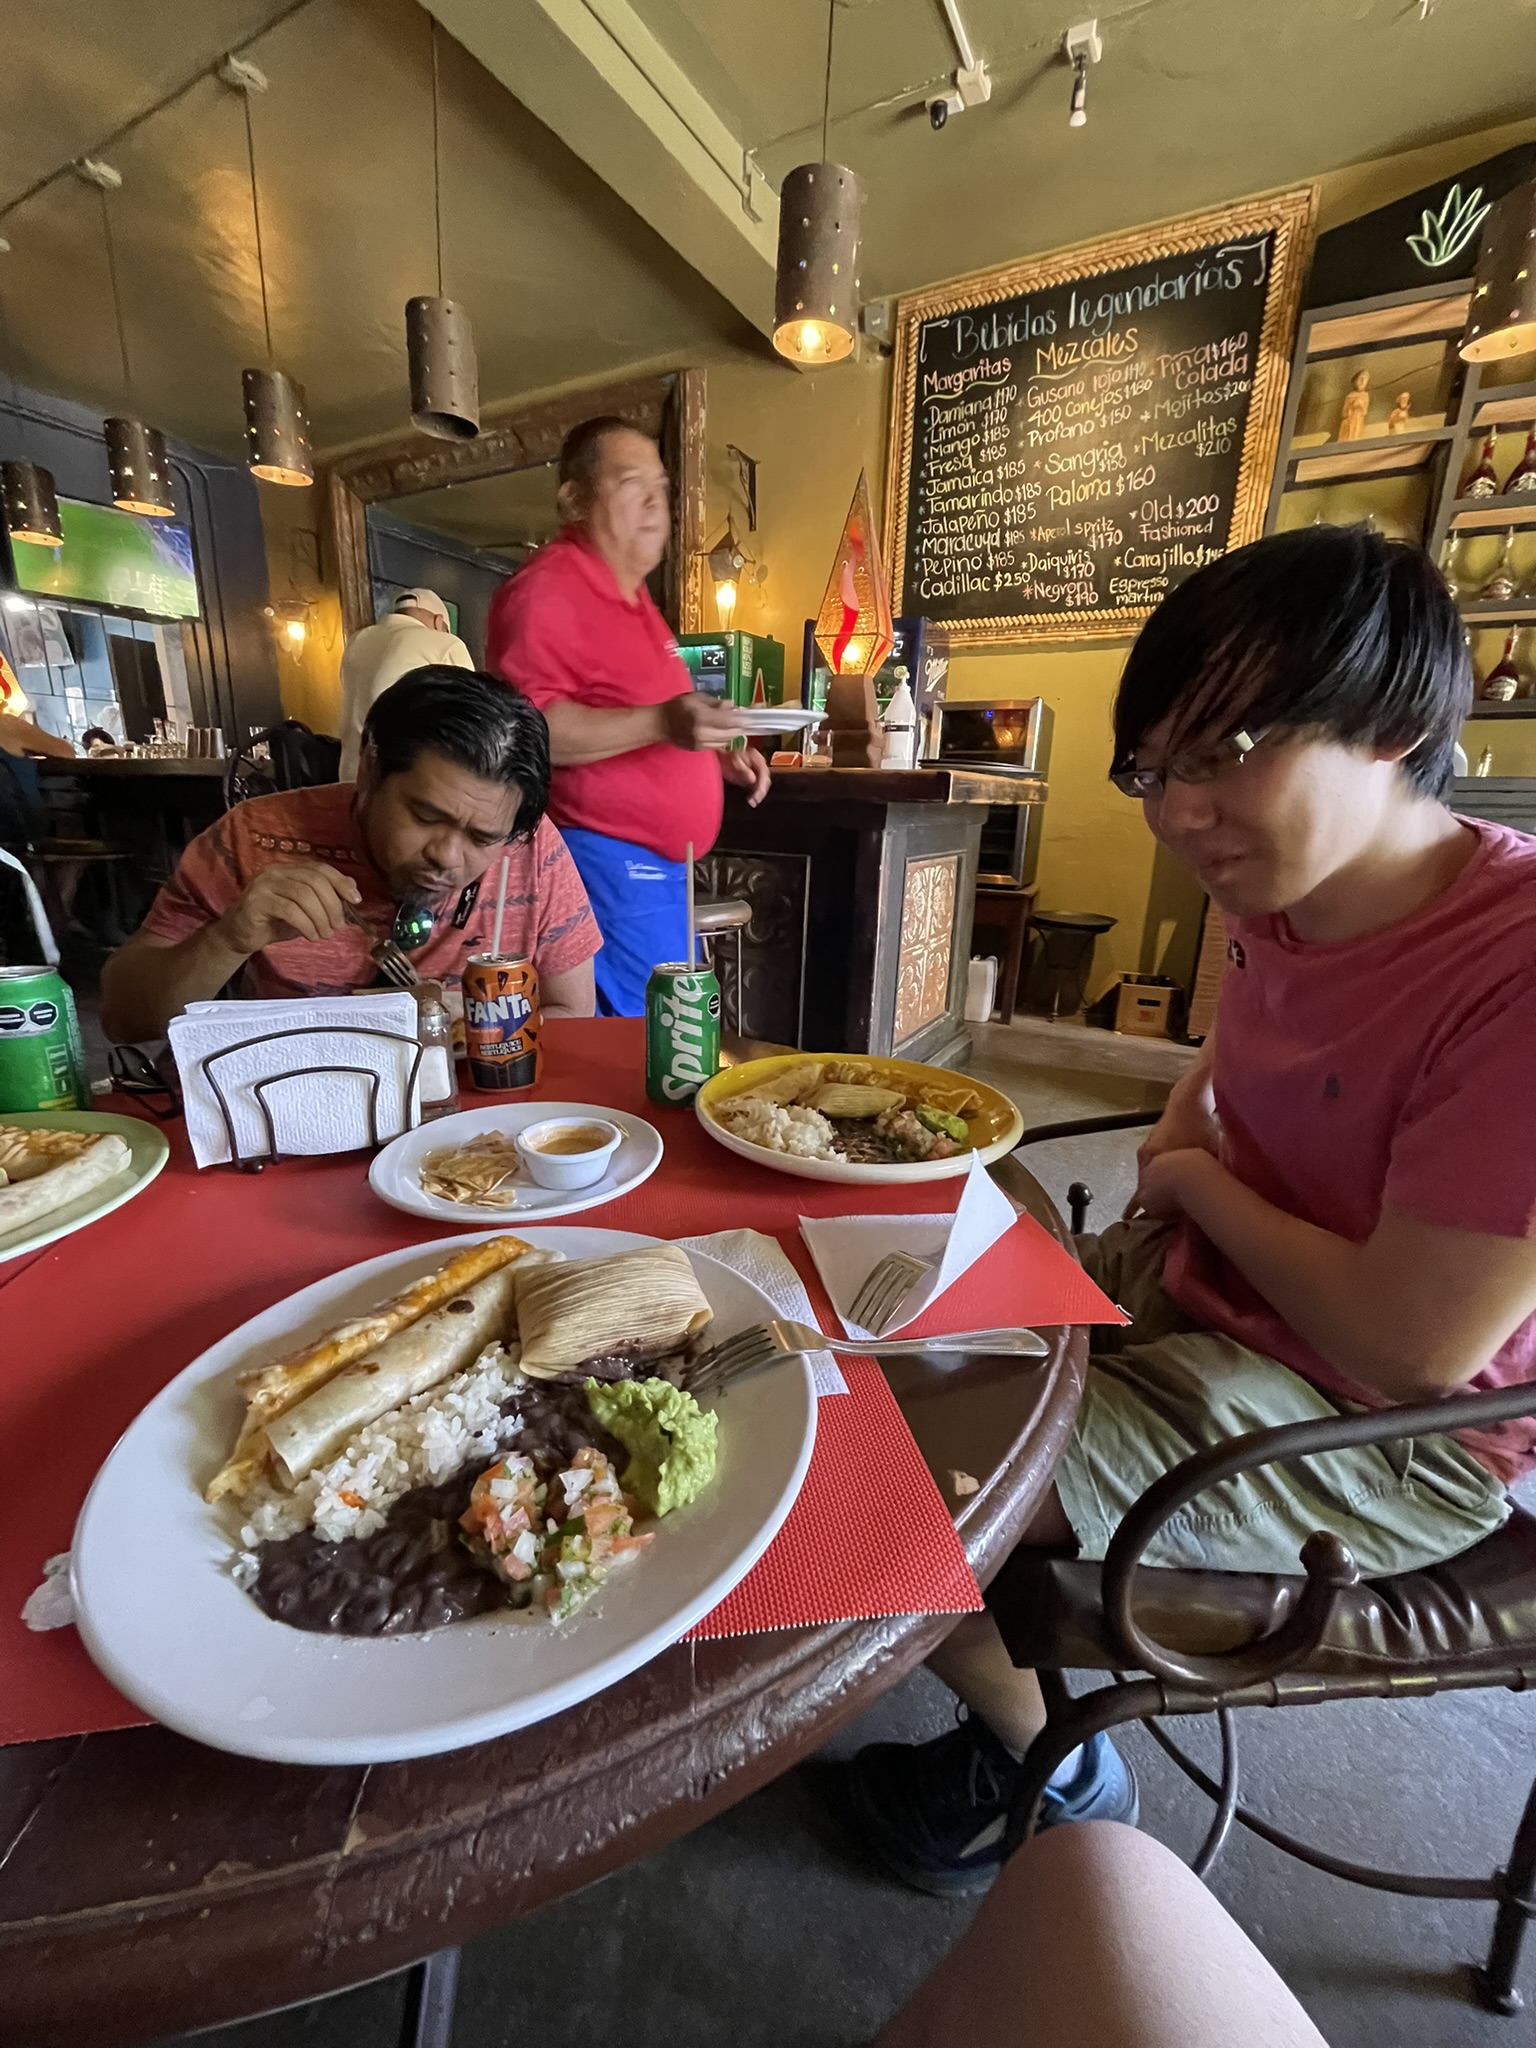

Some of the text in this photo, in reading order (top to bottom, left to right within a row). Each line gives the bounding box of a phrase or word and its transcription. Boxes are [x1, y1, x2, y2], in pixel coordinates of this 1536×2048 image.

[950, 259, 1244, 360] Bebidas legendarias
[1036, 328, 1138, 374] Mezcales
[1155, 331, 1248, 378] Piña $160
[923, 357, 1012, 396] Margaritas
[1027, 381, 1085, 408] Gusano
[1154, 388, 1223, 419] Mojitos
[927, 396, 992, 429] Damiana
[981, 407, 1008, 430] $170
[1027, 405, 1062, 428] 400
[1027, 405, 1132, 448] Profano $150
[930, 425, 1011, 459] Mango $185
[1141, 415, 1237, 456] Mezcalitas
[1195, 437, 1231, 458] $210
[926, 443, 1007, 477] Fresa $185
[1045, 440, 1123, 478] Sangria
[925, 459, 1026, 496] Jamaica $185
[1045, 464, 1156, 511] Paloma $160
[926, 482, 1042, 514] Tamarindo $185
[1141, 493, 1220, 522] Old $200
[922, 502, 1037, 535] Jalapeño $185
[1037, 517, 1070, 543] Aperol
[1138, 516, 1213, 542] Fashioned
[1004, 530, 1025, 548] $185
[1087, 529, 1123, 551] $170
[986, 550, 1015, 571] $185
[1027, 549, 1091, 577] Daiquiris
[1063, 562, 1096, 579] $170
[1124, 543, 1195, 574] Carajillo
[920, 571, 1031, 599] Cadillac $250
[1033, 580, 1094, 602] Negroni
